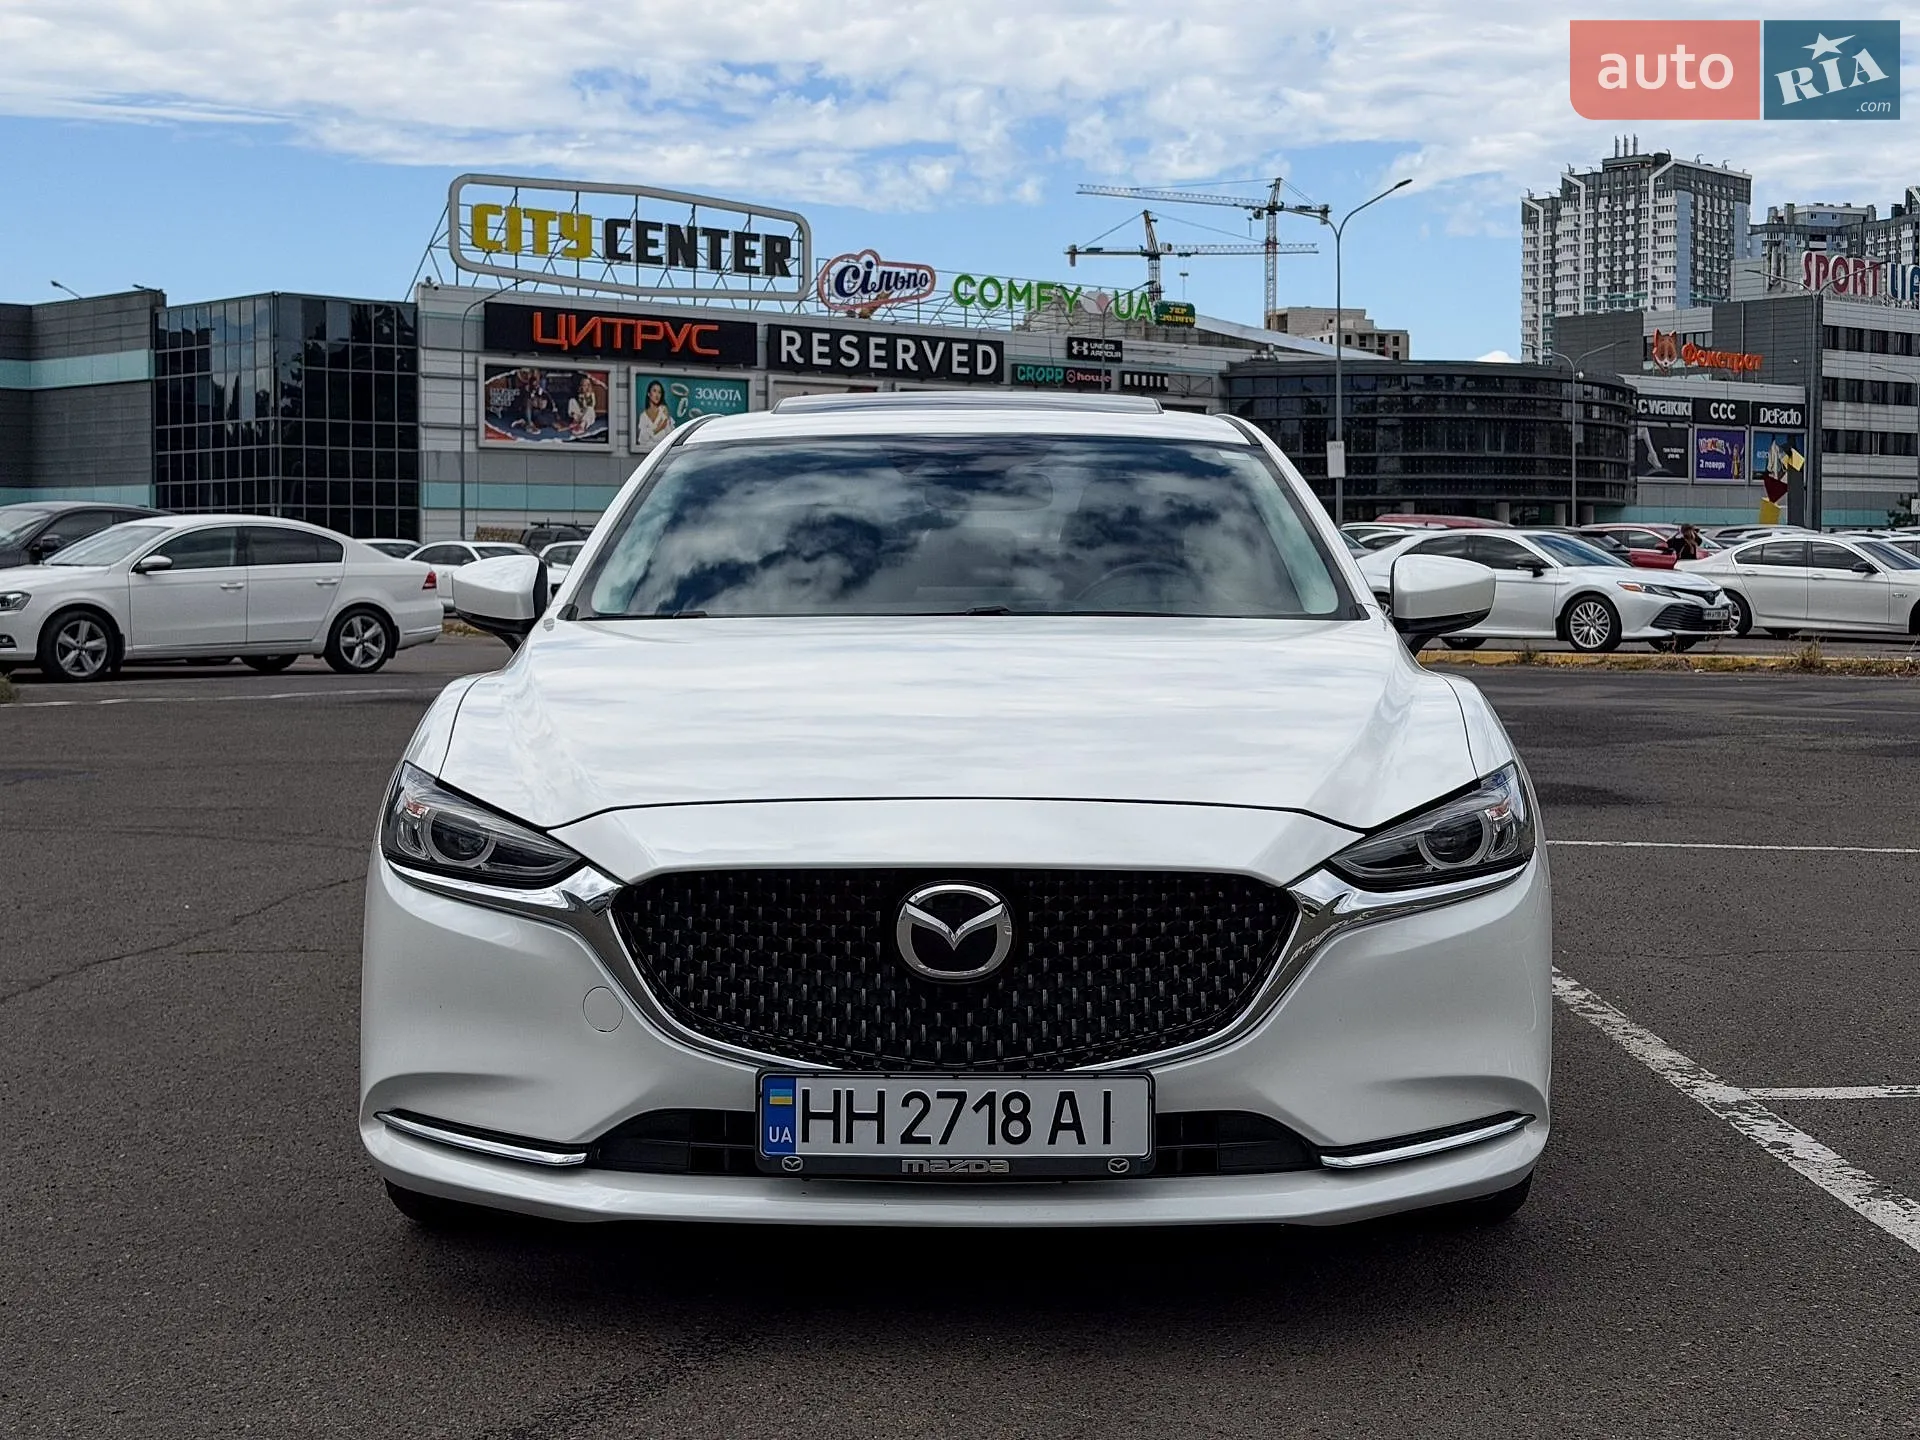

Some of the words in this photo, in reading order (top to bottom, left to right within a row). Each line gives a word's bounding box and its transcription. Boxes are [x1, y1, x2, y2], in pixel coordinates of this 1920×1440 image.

[471, 204, 593, 259] CITY
[602, 217, 792, 278] CENTER
[835, 260, 929, 298] Сільпо
[1802, 250, 1880, 298] SPORT
[952, 273, 1083, 315] COMFY
[1113, 289, 1154, 321] UA
[533, 311, 720, 356] ЦИТРУС
[780, 329, 998, 376] RESERVED
[1017, 365, 1064, 382] CROPP
[1709, 402, 1736, 420] CCC
[1759, 407, 1802, 426] DeFacto
[769, 1126, 793, 1144] UA
[900, 1090, 1032, 1145] 2718
